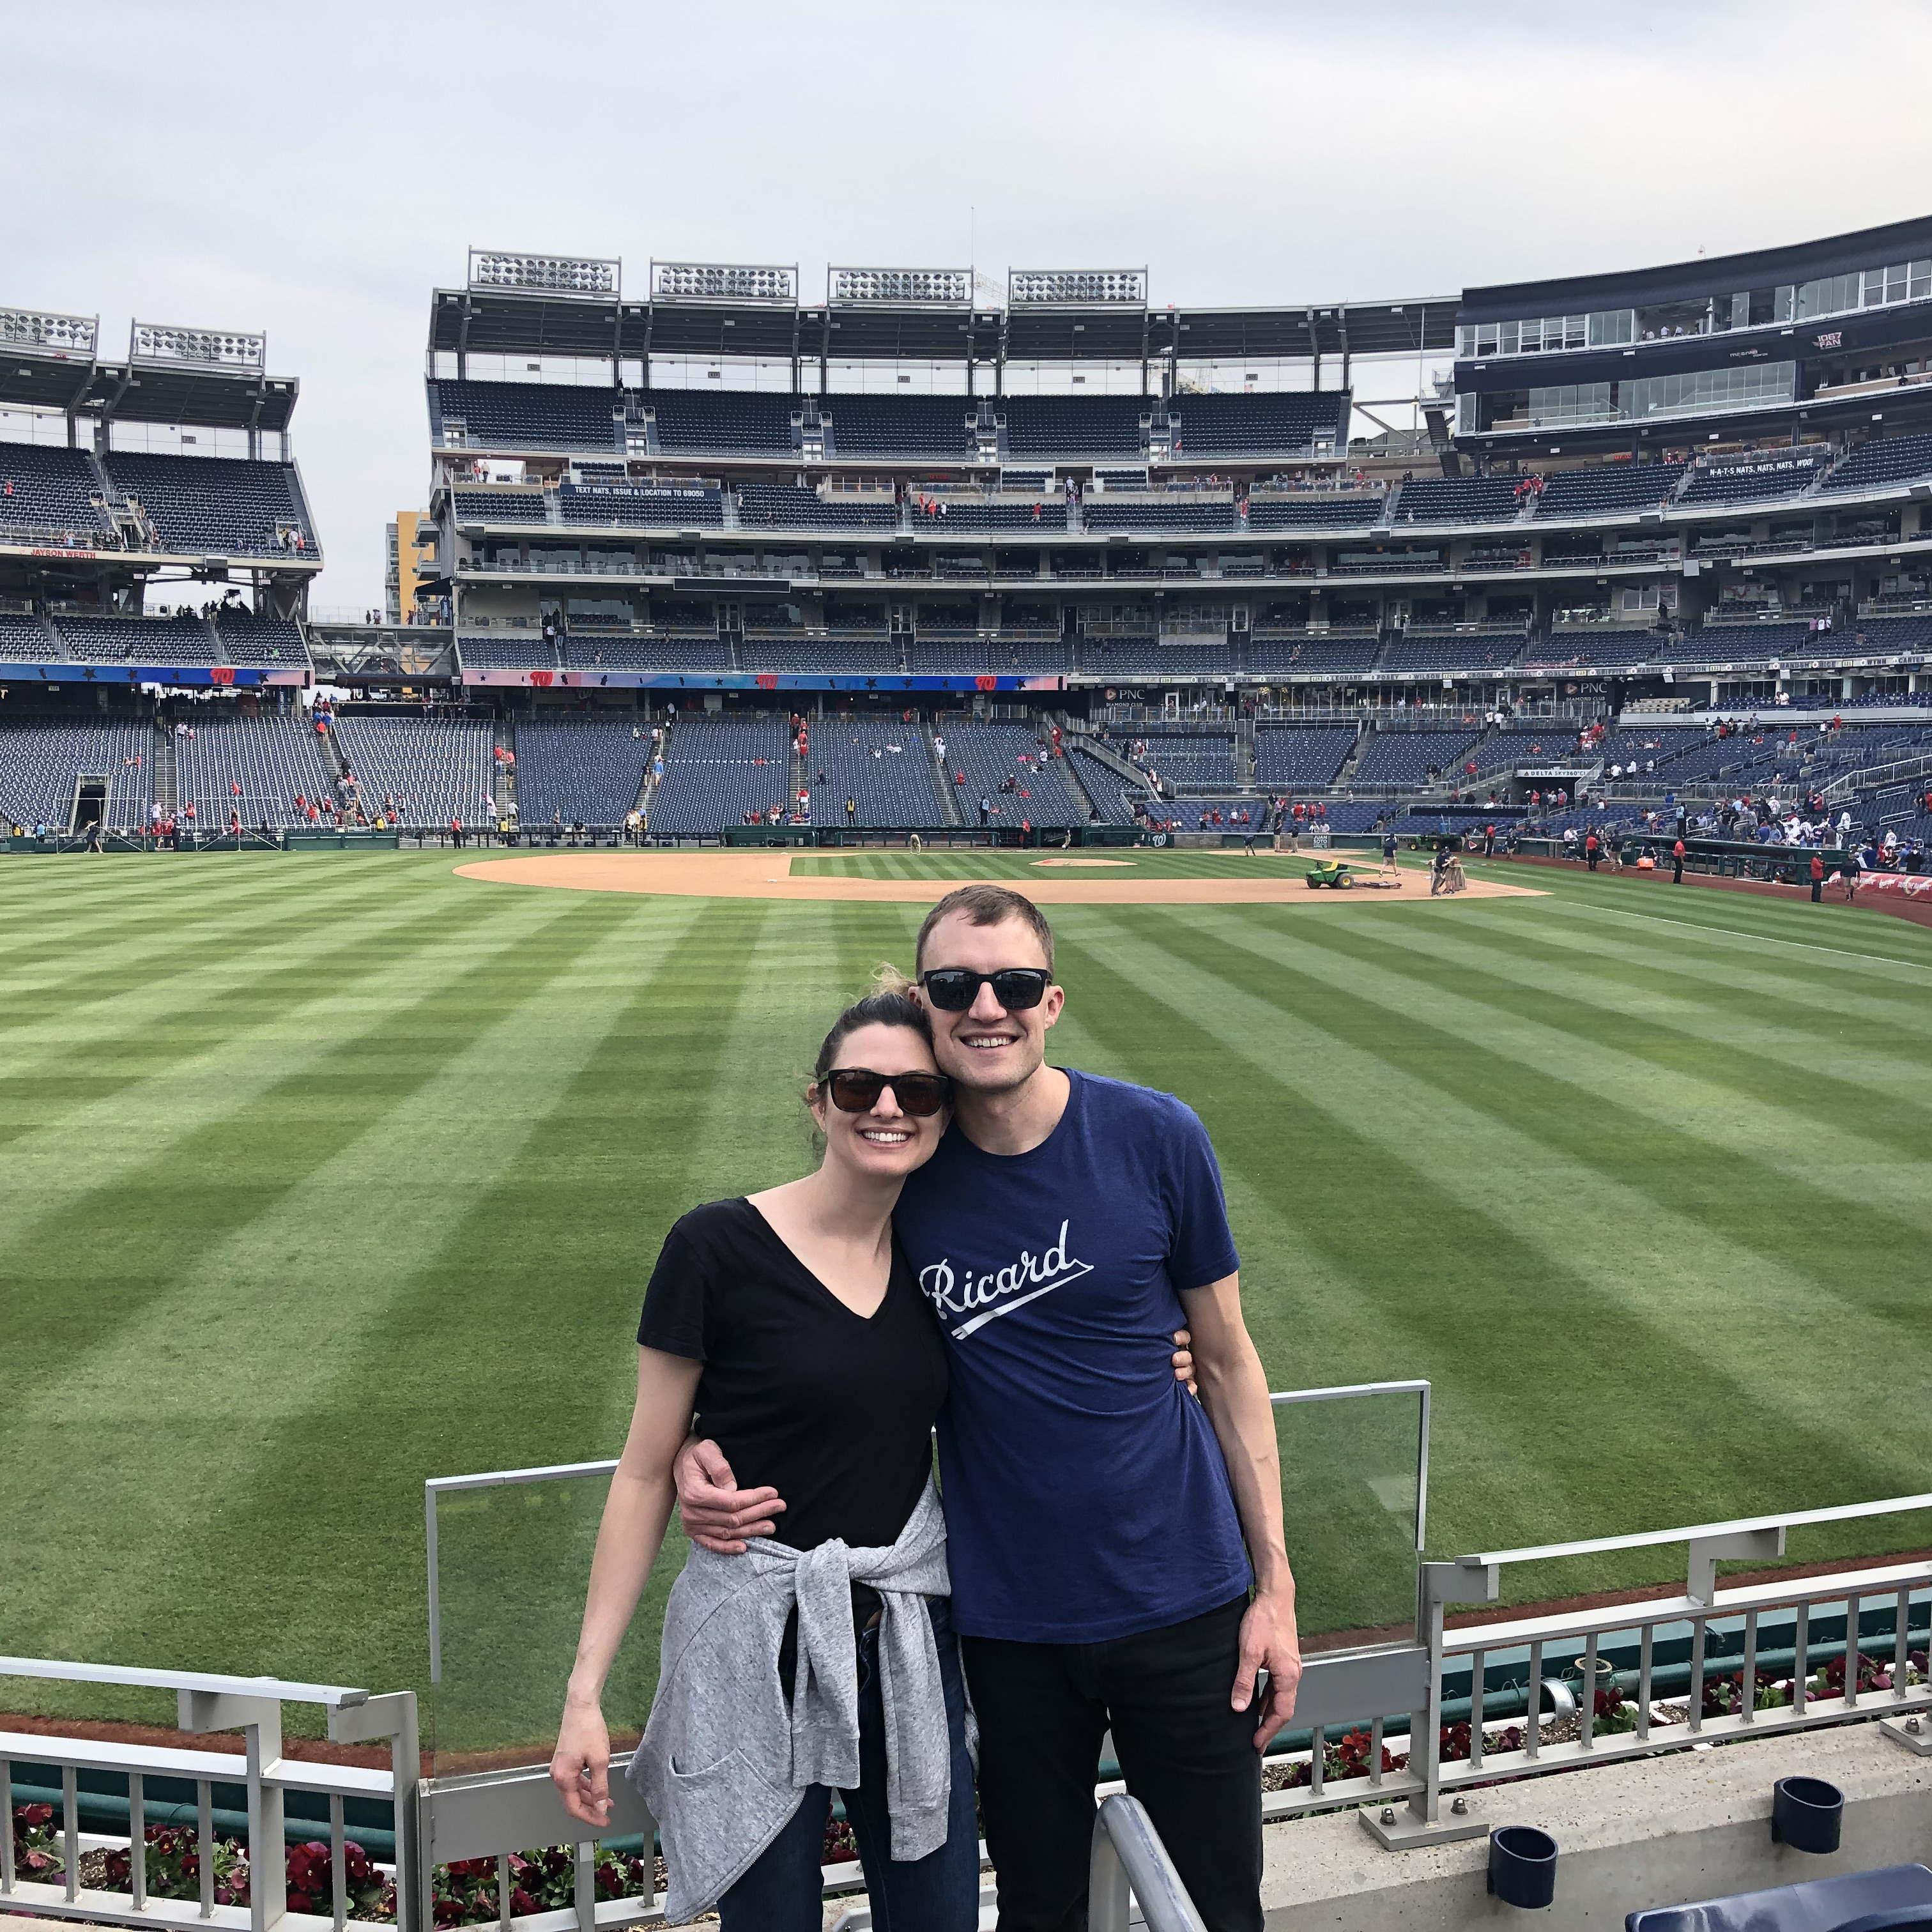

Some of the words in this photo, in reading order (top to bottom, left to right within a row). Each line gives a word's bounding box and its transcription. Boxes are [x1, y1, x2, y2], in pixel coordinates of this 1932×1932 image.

[1820, 339, 1841, 348] FAN
[1710, 467, 1735, 476] N-A-T-S
[1736, 466, 1756, 474] NATS,
[1757, 464, 1775, 473] NATS,
[1777, 461, 1795, 470] NATS,
[1797, 458, 1814, 467] WOO!
[592, 487, 611, 496] NATS,
[65, 551, 96, 559] WERTH
[1581, 682, 1607, 693] PNC
[1119, 689, 1145, 700] PNC
[919, 1219, 1094, 1320] Ricard
